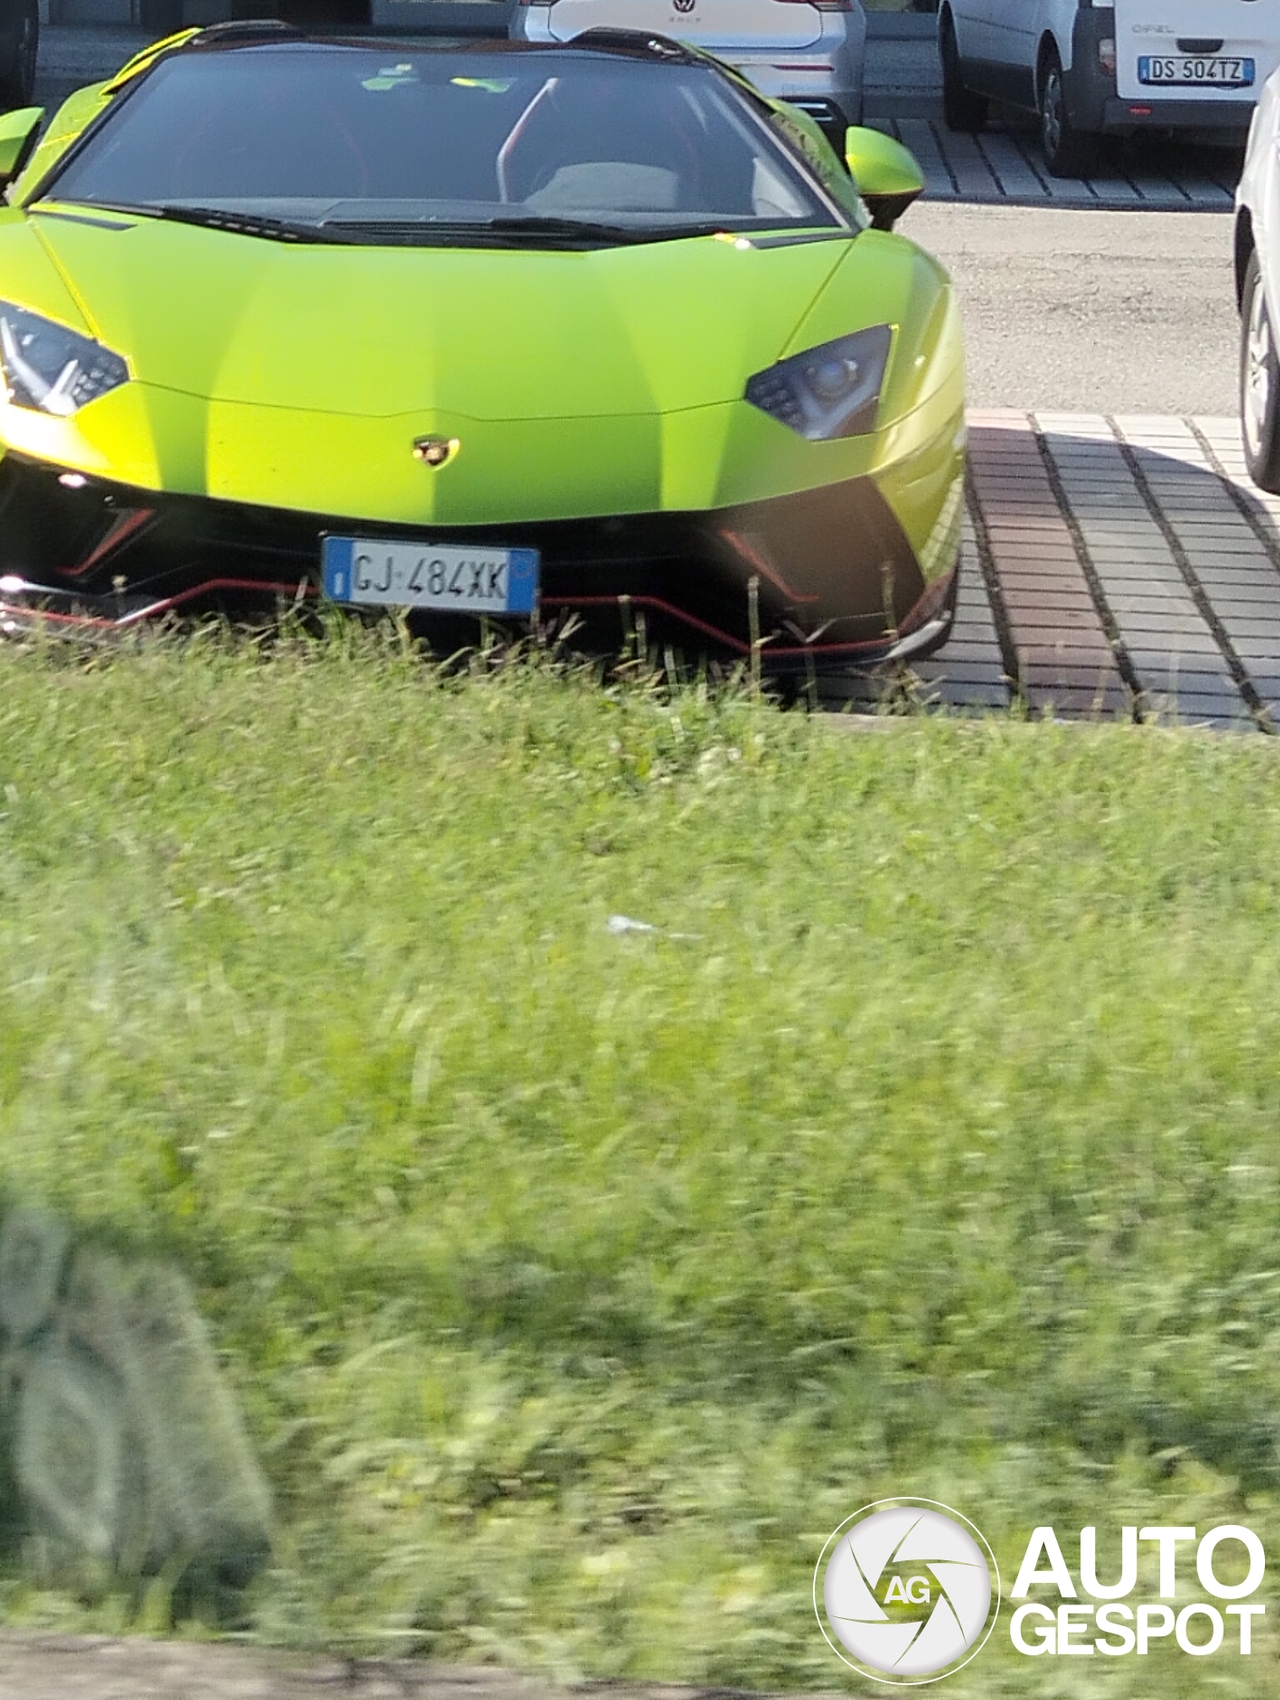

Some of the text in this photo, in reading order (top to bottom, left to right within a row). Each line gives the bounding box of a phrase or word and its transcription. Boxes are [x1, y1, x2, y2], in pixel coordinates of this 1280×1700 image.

[1152, 60, 1242, 80] DS 504TZ
[355, 555, 506, 599] GJ 484XK
